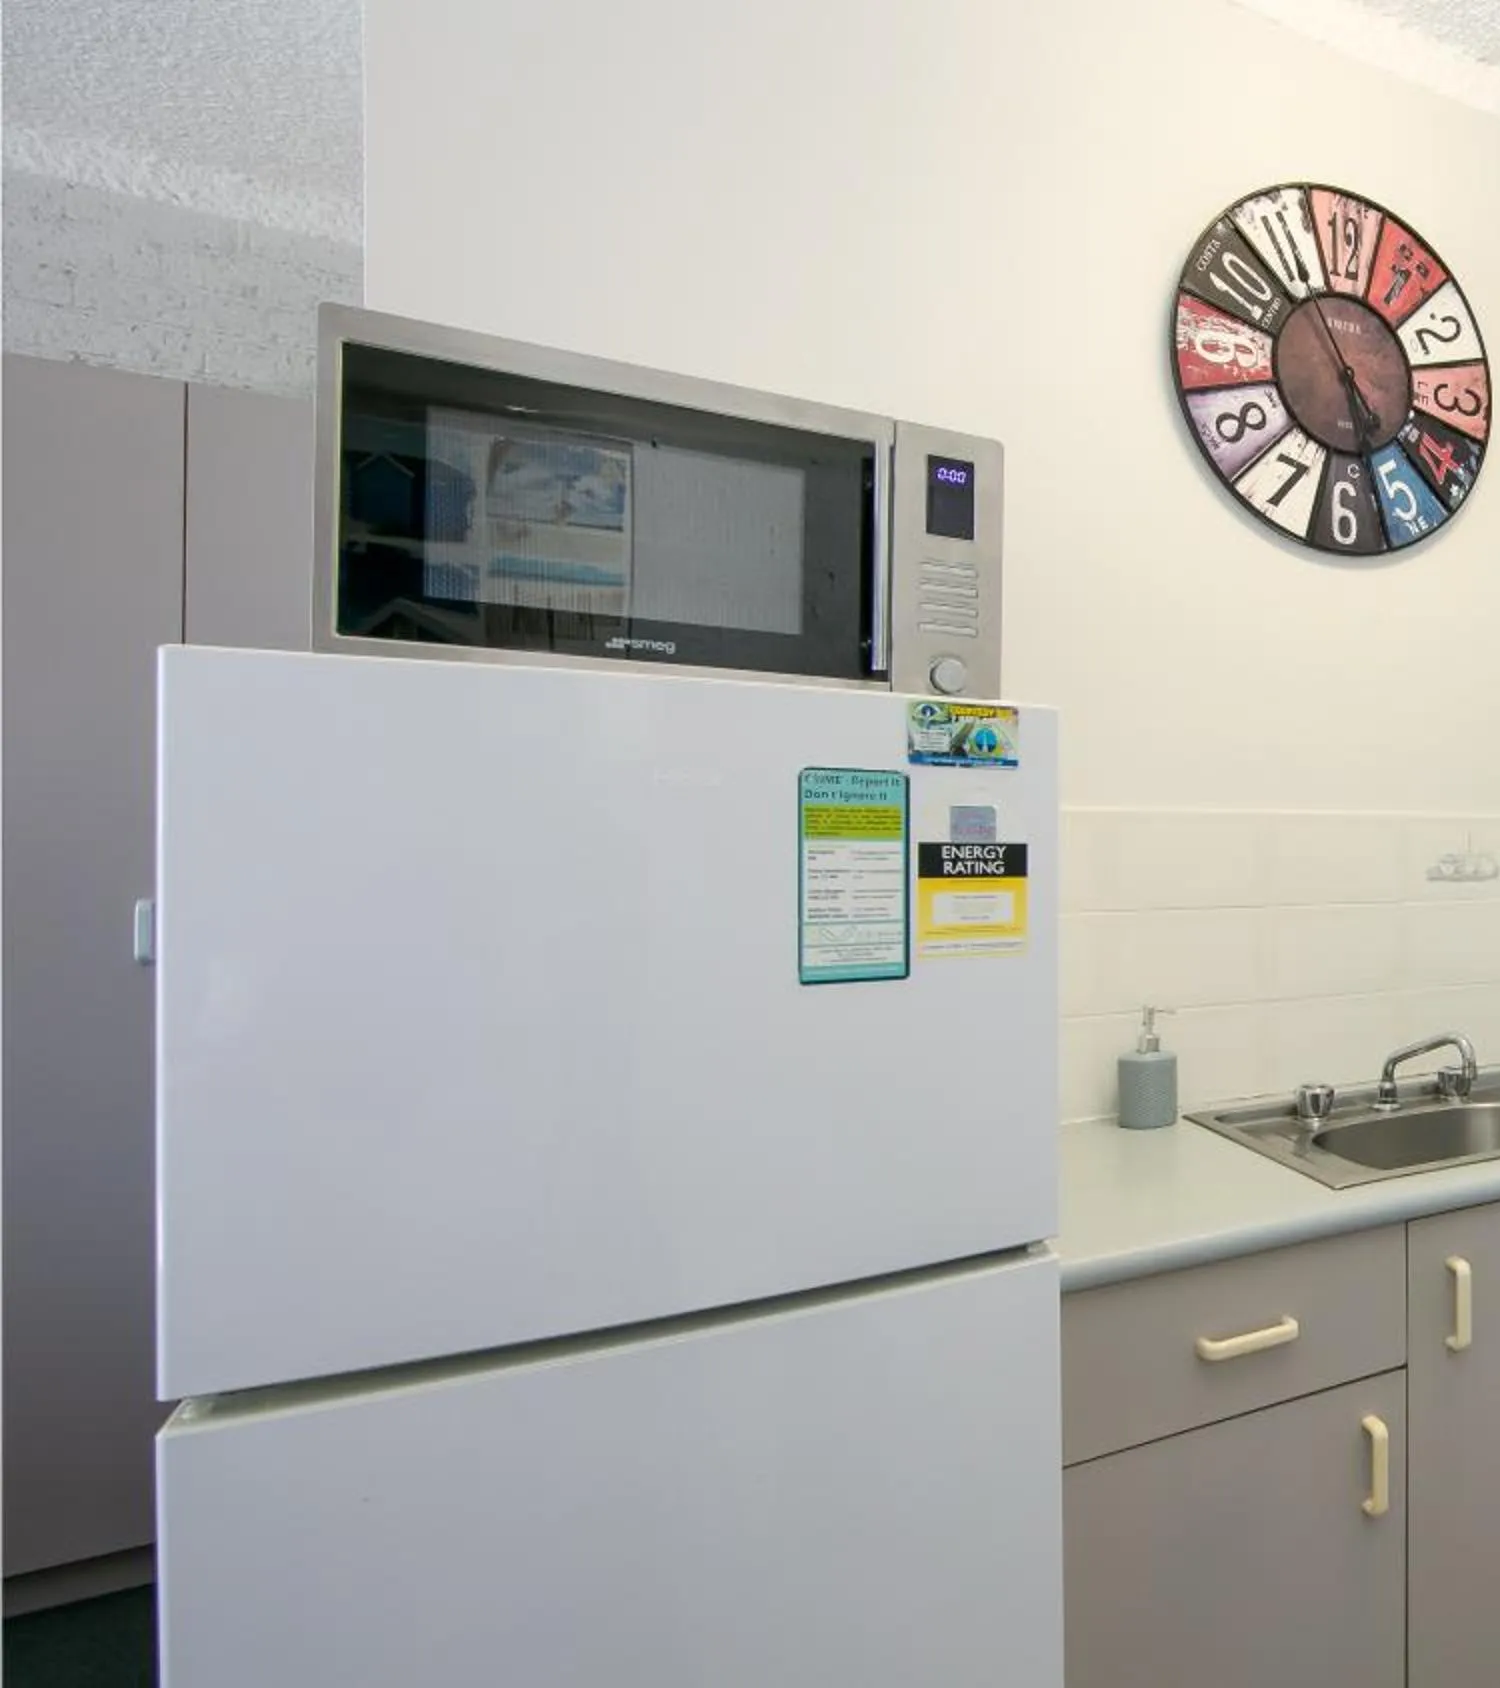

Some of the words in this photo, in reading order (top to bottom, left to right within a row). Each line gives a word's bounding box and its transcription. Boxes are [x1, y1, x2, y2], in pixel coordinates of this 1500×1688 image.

[1328, 212, 1359, 281] 12
[1209, 252, 1272, 320] 10
[1195, 330, 1259, 369] 9
[1415, 315, 1461, 355] 2
[1433, 383, 1482, 416] 3
[1216, 402, 1267, 443] 8
[1416, 432, 1461, 486] 4
[1266, 454, 1310, 508] 7
[1378, 459, 1418, 521] 5
[1331, 481, 1358, 545] 6
[631, 639, 676, 655] smeg
[941, 845, 1007, 860] ENERGY
[943, 860, 1005, 875] RATING
